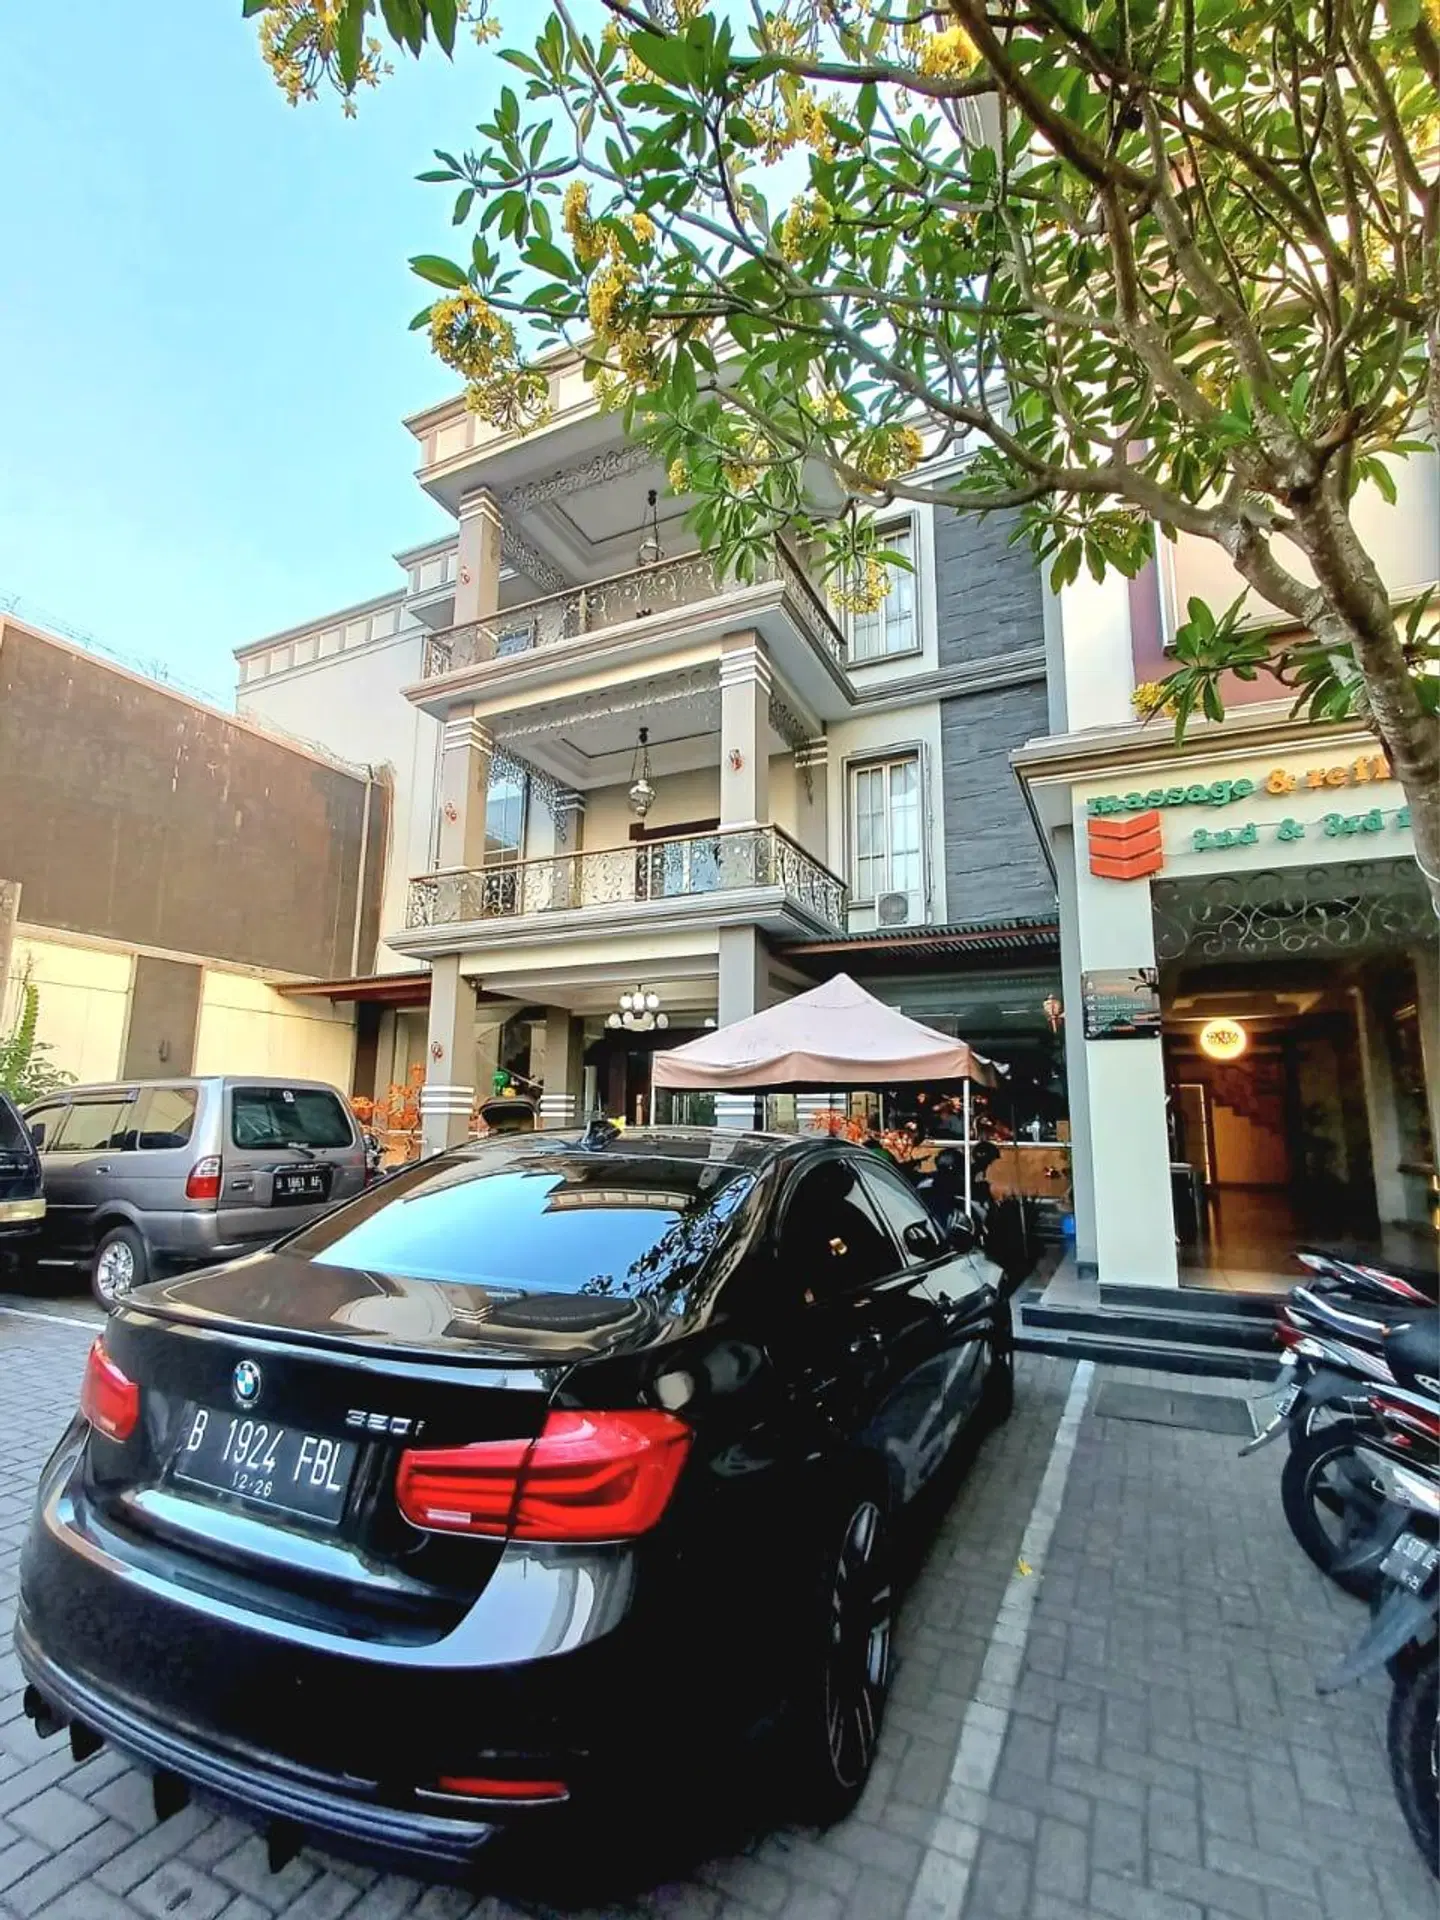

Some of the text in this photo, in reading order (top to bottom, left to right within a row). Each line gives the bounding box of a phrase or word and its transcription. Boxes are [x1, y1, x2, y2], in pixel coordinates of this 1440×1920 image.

[1087, 754, 1392, 815] massage & refl
[1193, 821, 1259, 852] 2nd
[1277, 818, 1306, 842] &
[1324, 809, 1386, 837] 3rd
[346, 1409, 426, 1437] 320i
[188, 1409, 342, 1493] B 1924 FBL
